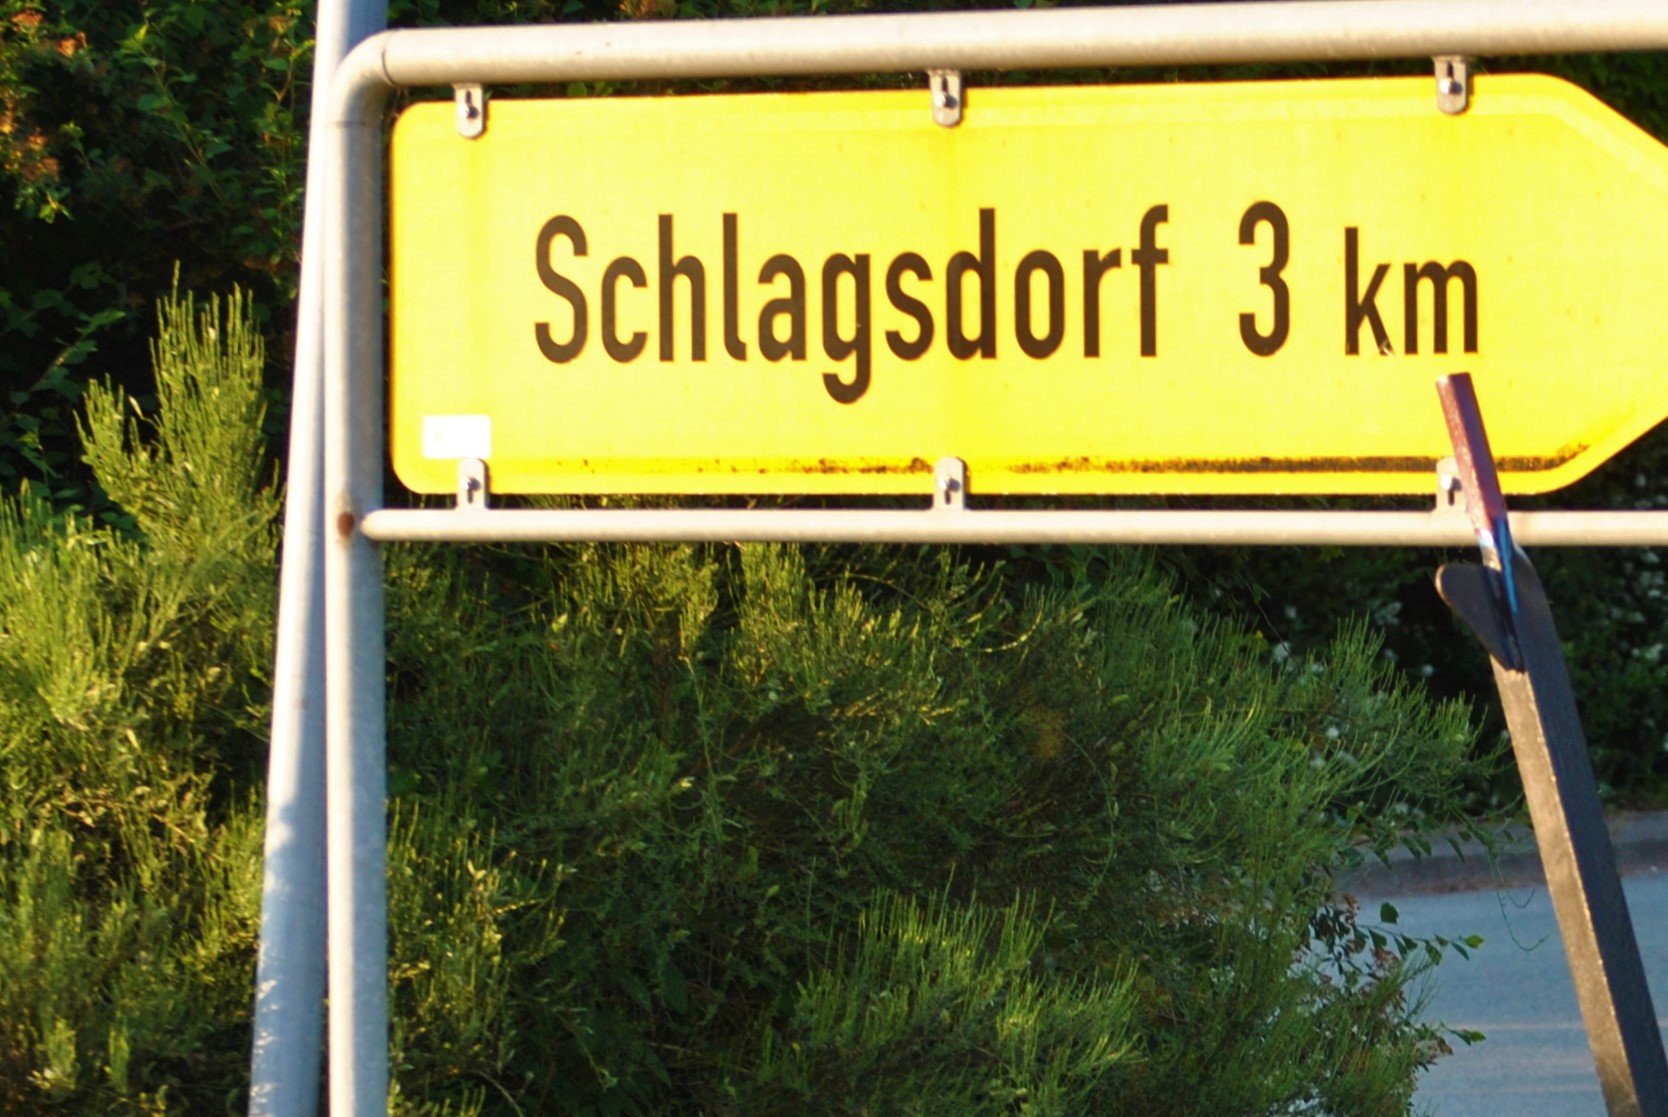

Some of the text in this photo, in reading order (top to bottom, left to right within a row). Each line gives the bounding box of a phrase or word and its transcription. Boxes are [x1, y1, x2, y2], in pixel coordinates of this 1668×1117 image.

[534, 200, 1479, 405] Schlagsdorf 3 km
